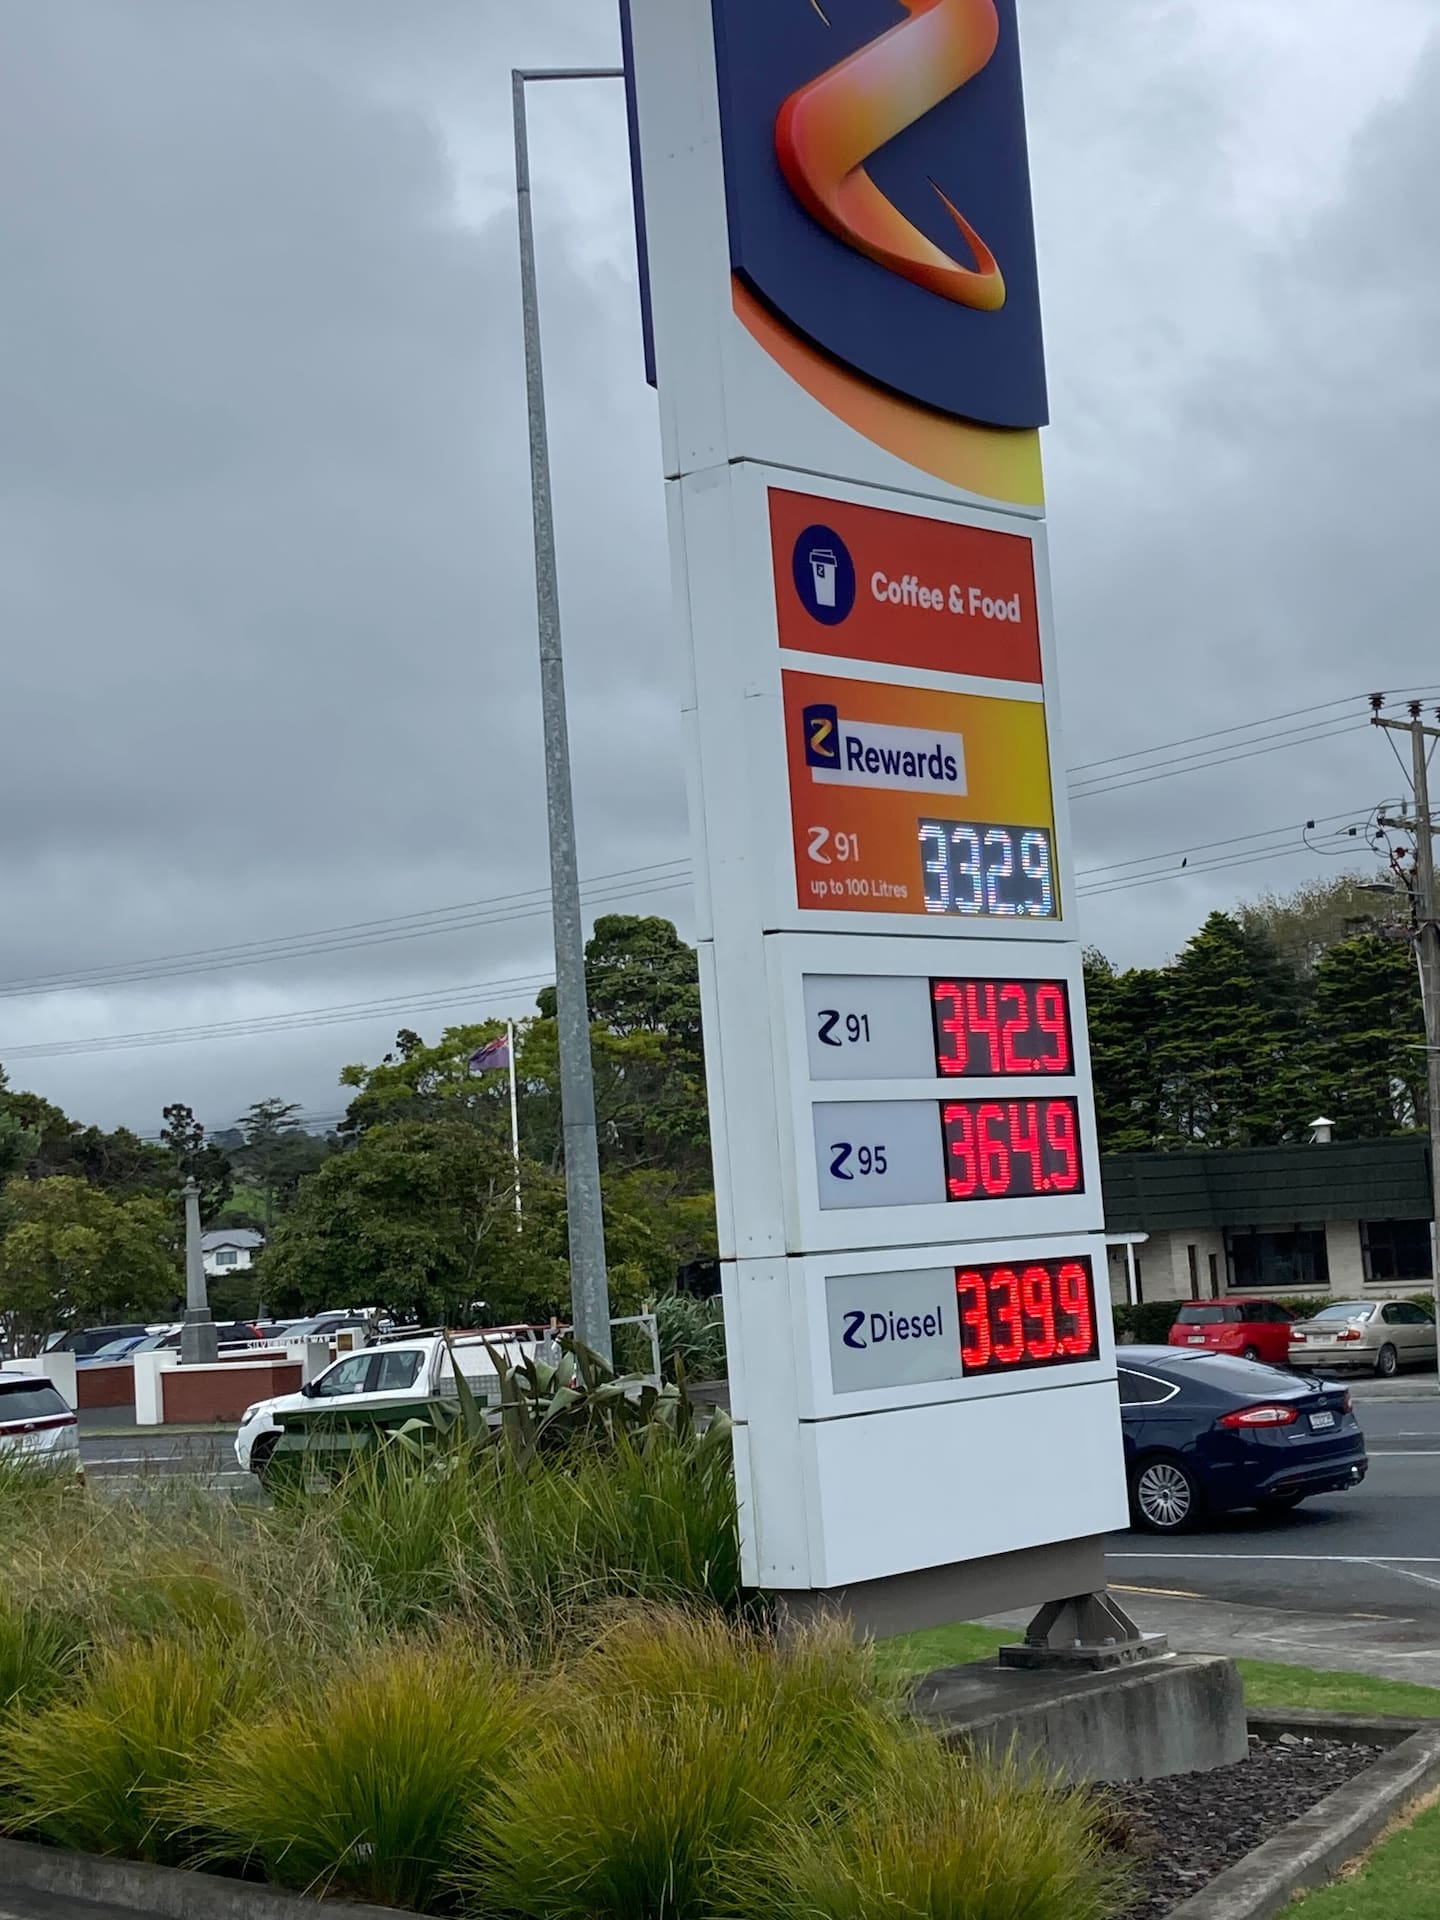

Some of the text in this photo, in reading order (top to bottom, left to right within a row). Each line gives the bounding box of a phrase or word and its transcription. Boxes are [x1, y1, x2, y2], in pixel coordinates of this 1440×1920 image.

[871, 571, 1021, 623] Coffee & Food
[845, 736, 958, 782] Rewards
[834, 832, 860, 862] 91
[811, 878, 908, 898] up to 100 Litres
[918, 825, 1052, 917] 332.9
[846, 1014, 870, 1043] 91
[934, 984, 1069, 1074] 342.9
[858, 1146, 887, 1175] 95
[944, 1101, 1079, 1197] 364.9
[870, 1305, 943, 1344] Diesel
[957, 1262, 1093, 1369] 339.9
